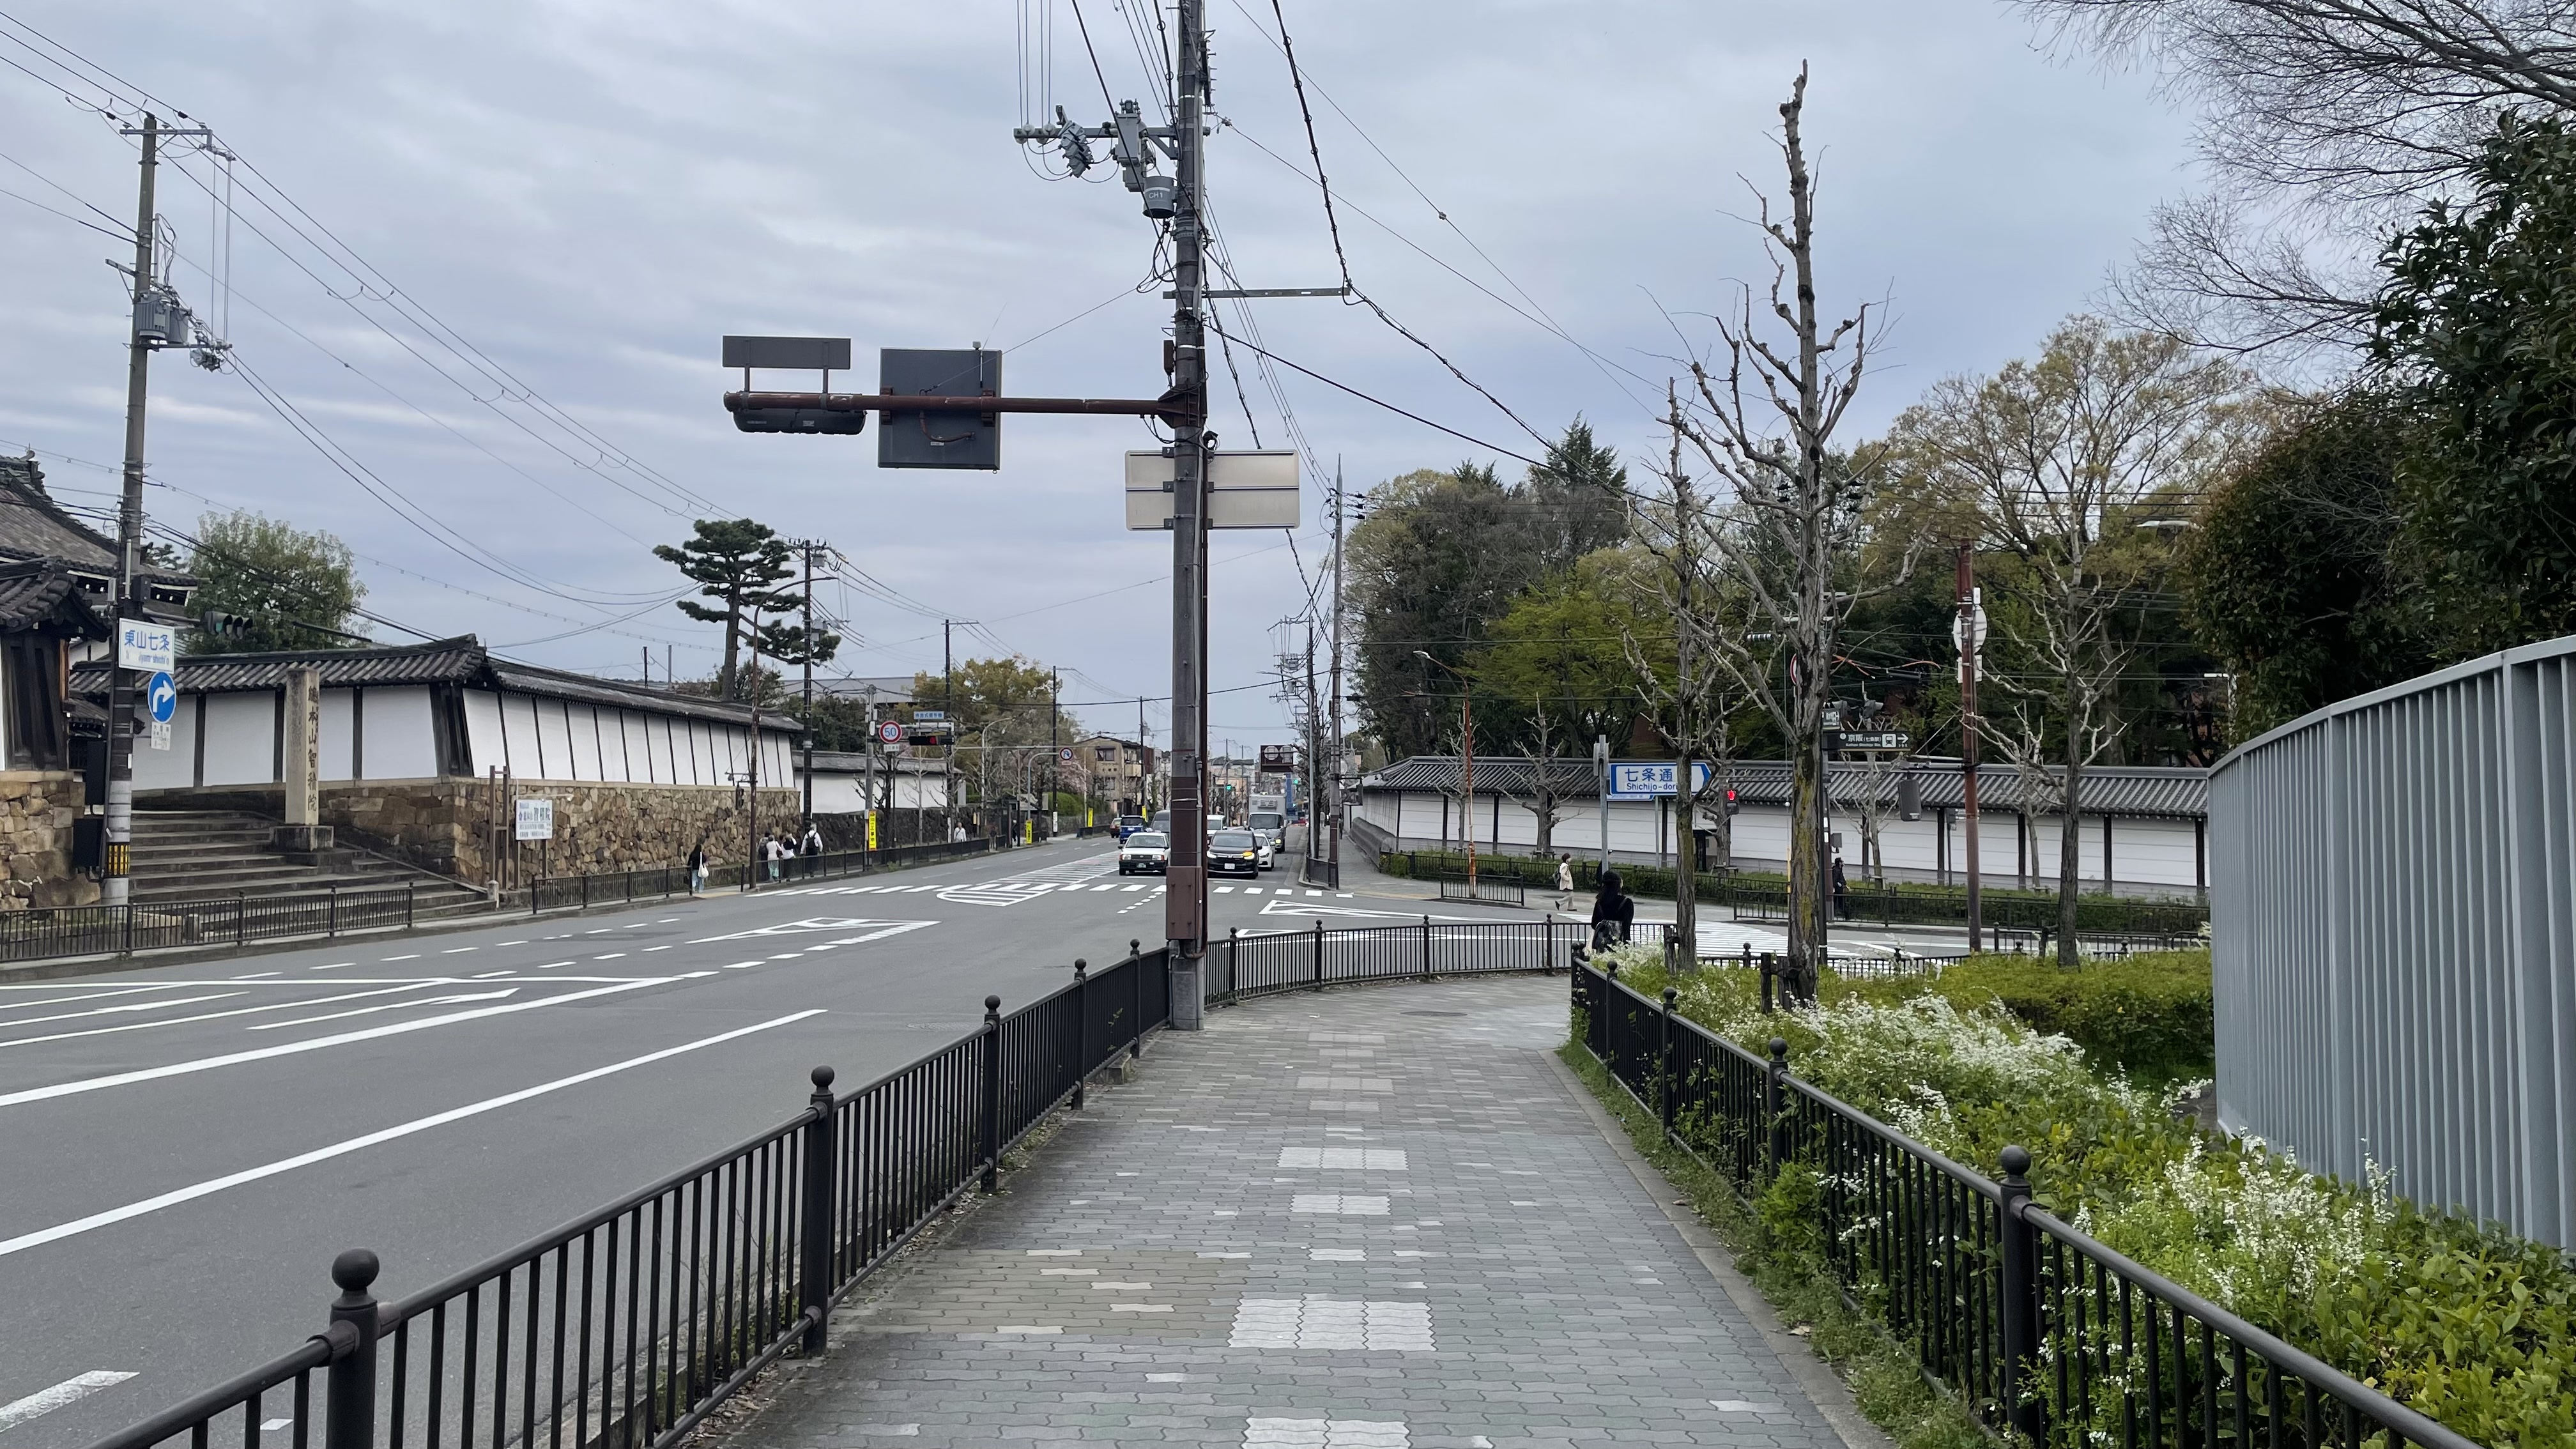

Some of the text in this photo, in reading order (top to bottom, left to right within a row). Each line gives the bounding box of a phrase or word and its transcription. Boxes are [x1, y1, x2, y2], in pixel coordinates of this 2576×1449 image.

[125, 629, 169, 652] 東山七条
[884, 727, 896, 737] 50
[1624, 768, 1673, 782] 七条通
